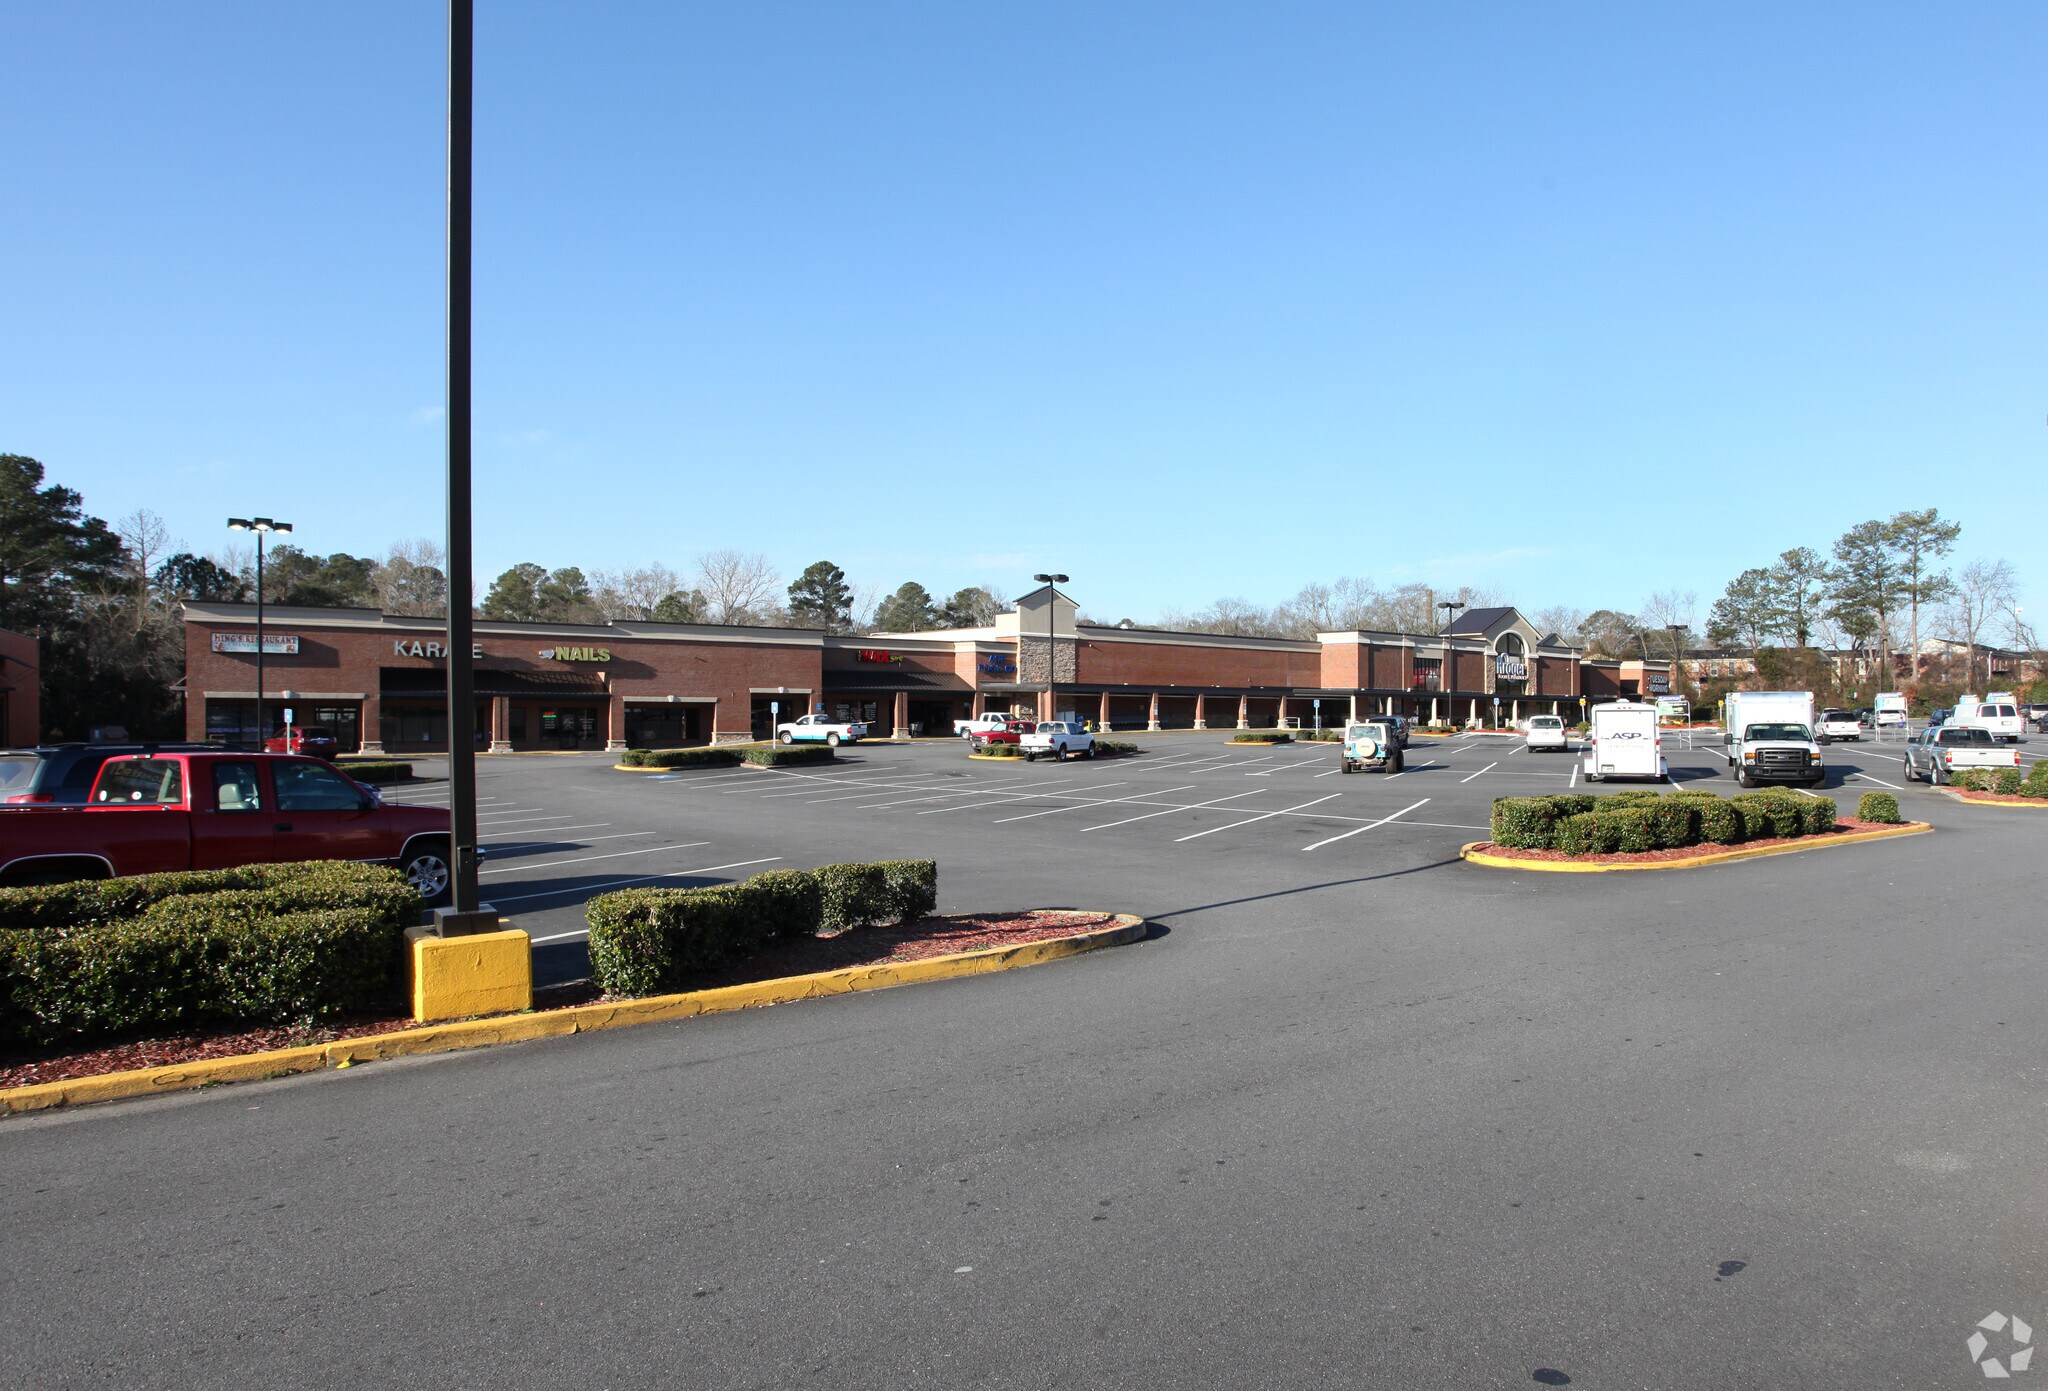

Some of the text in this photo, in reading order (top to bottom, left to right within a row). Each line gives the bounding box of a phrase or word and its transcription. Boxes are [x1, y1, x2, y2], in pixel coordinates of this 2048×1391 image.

[393, 640, 483, 659] KARE
[555, 646, 611, 662] NAILS
[1496, 653, 1525, 676] Kroger
[1611, 732, 1642, 740] ASP
